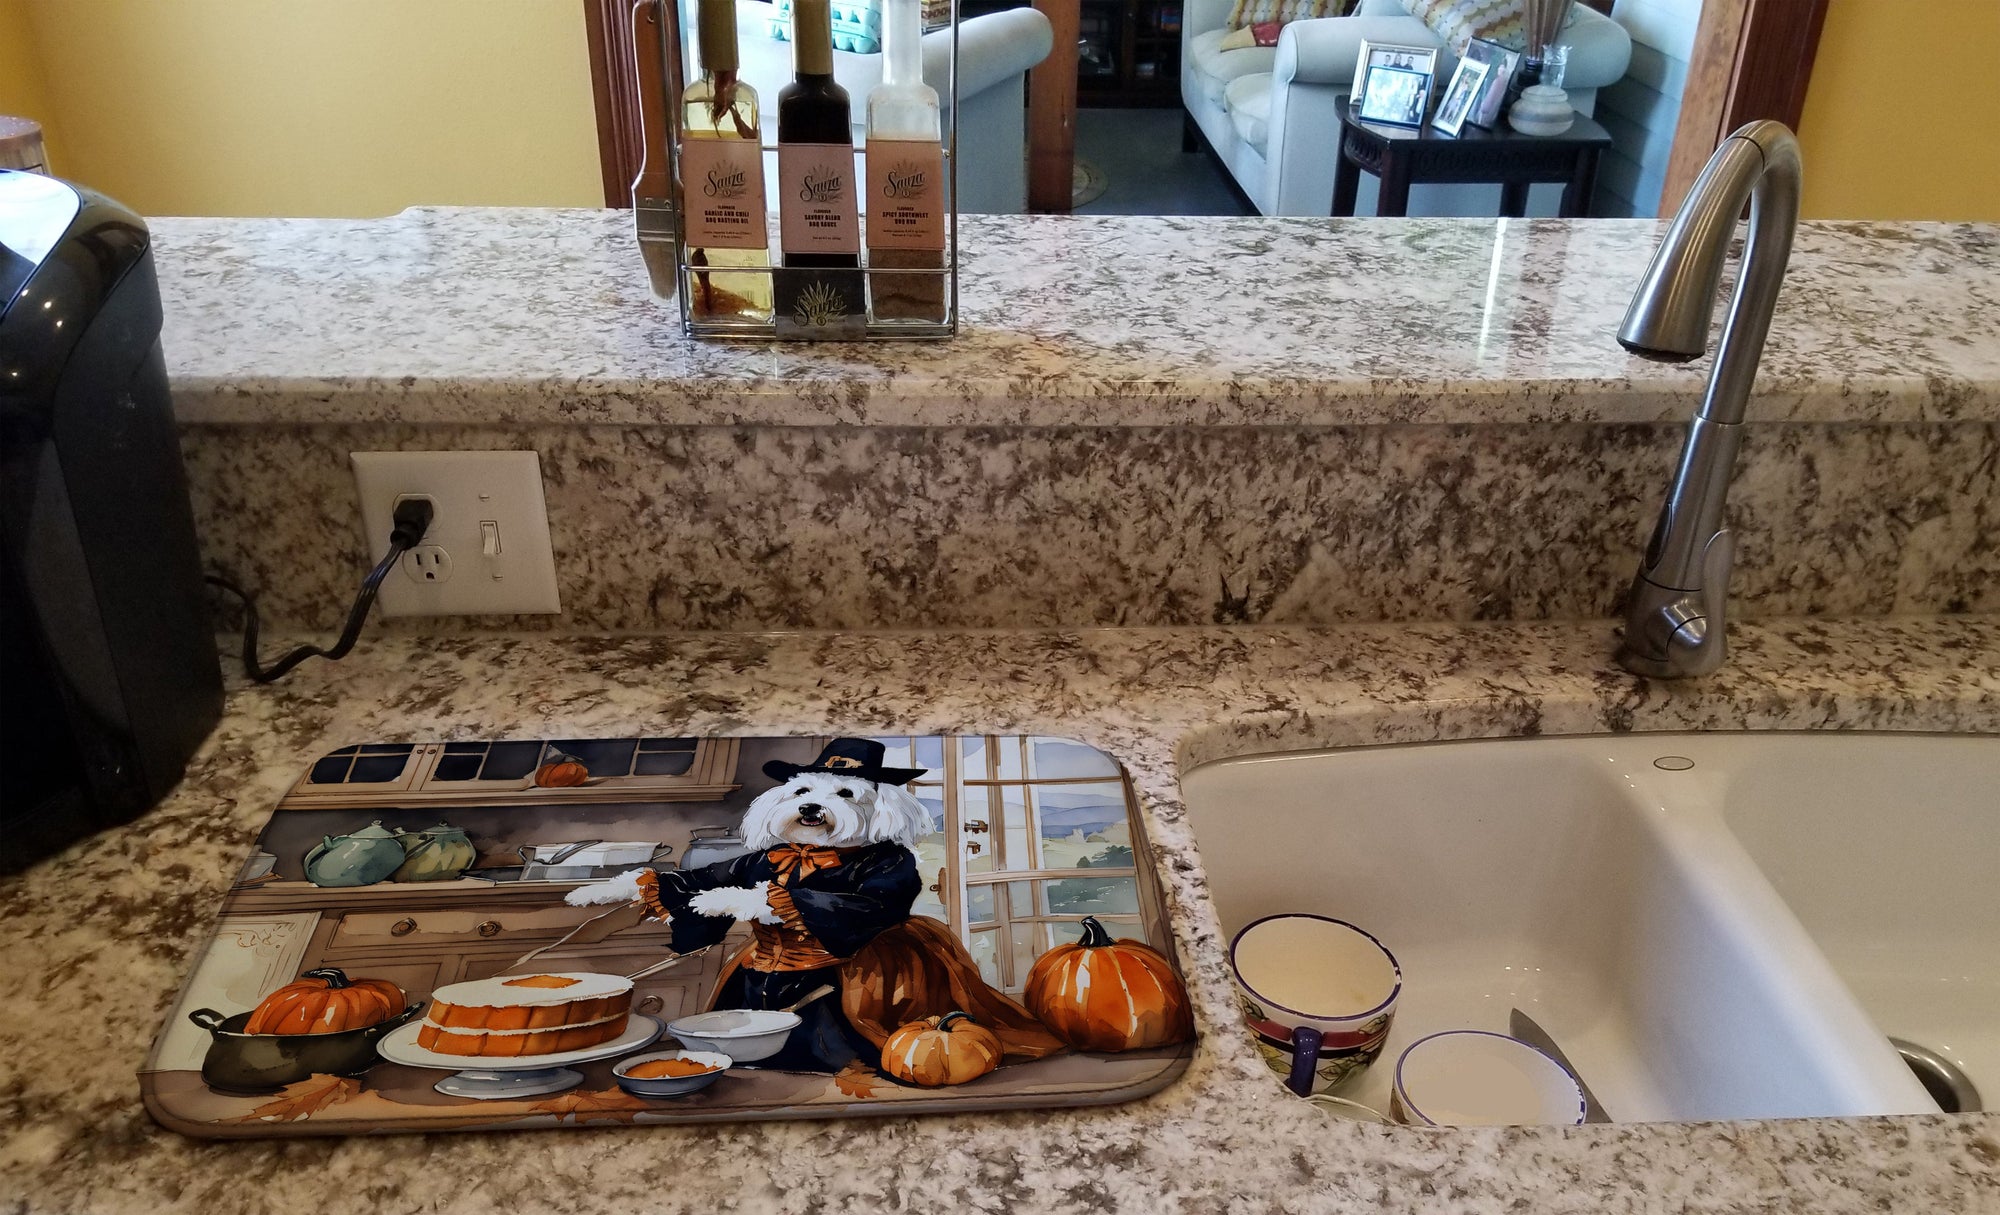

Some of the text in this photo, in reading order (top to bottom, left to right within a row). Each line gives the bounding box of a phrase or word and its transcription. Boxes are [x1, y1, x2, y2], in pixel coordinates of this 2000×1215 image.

[704, 170, 745, 197] Sauza
[800, 175, 842, 202] Sauza
[884, 171, 926, 198] Sauza
